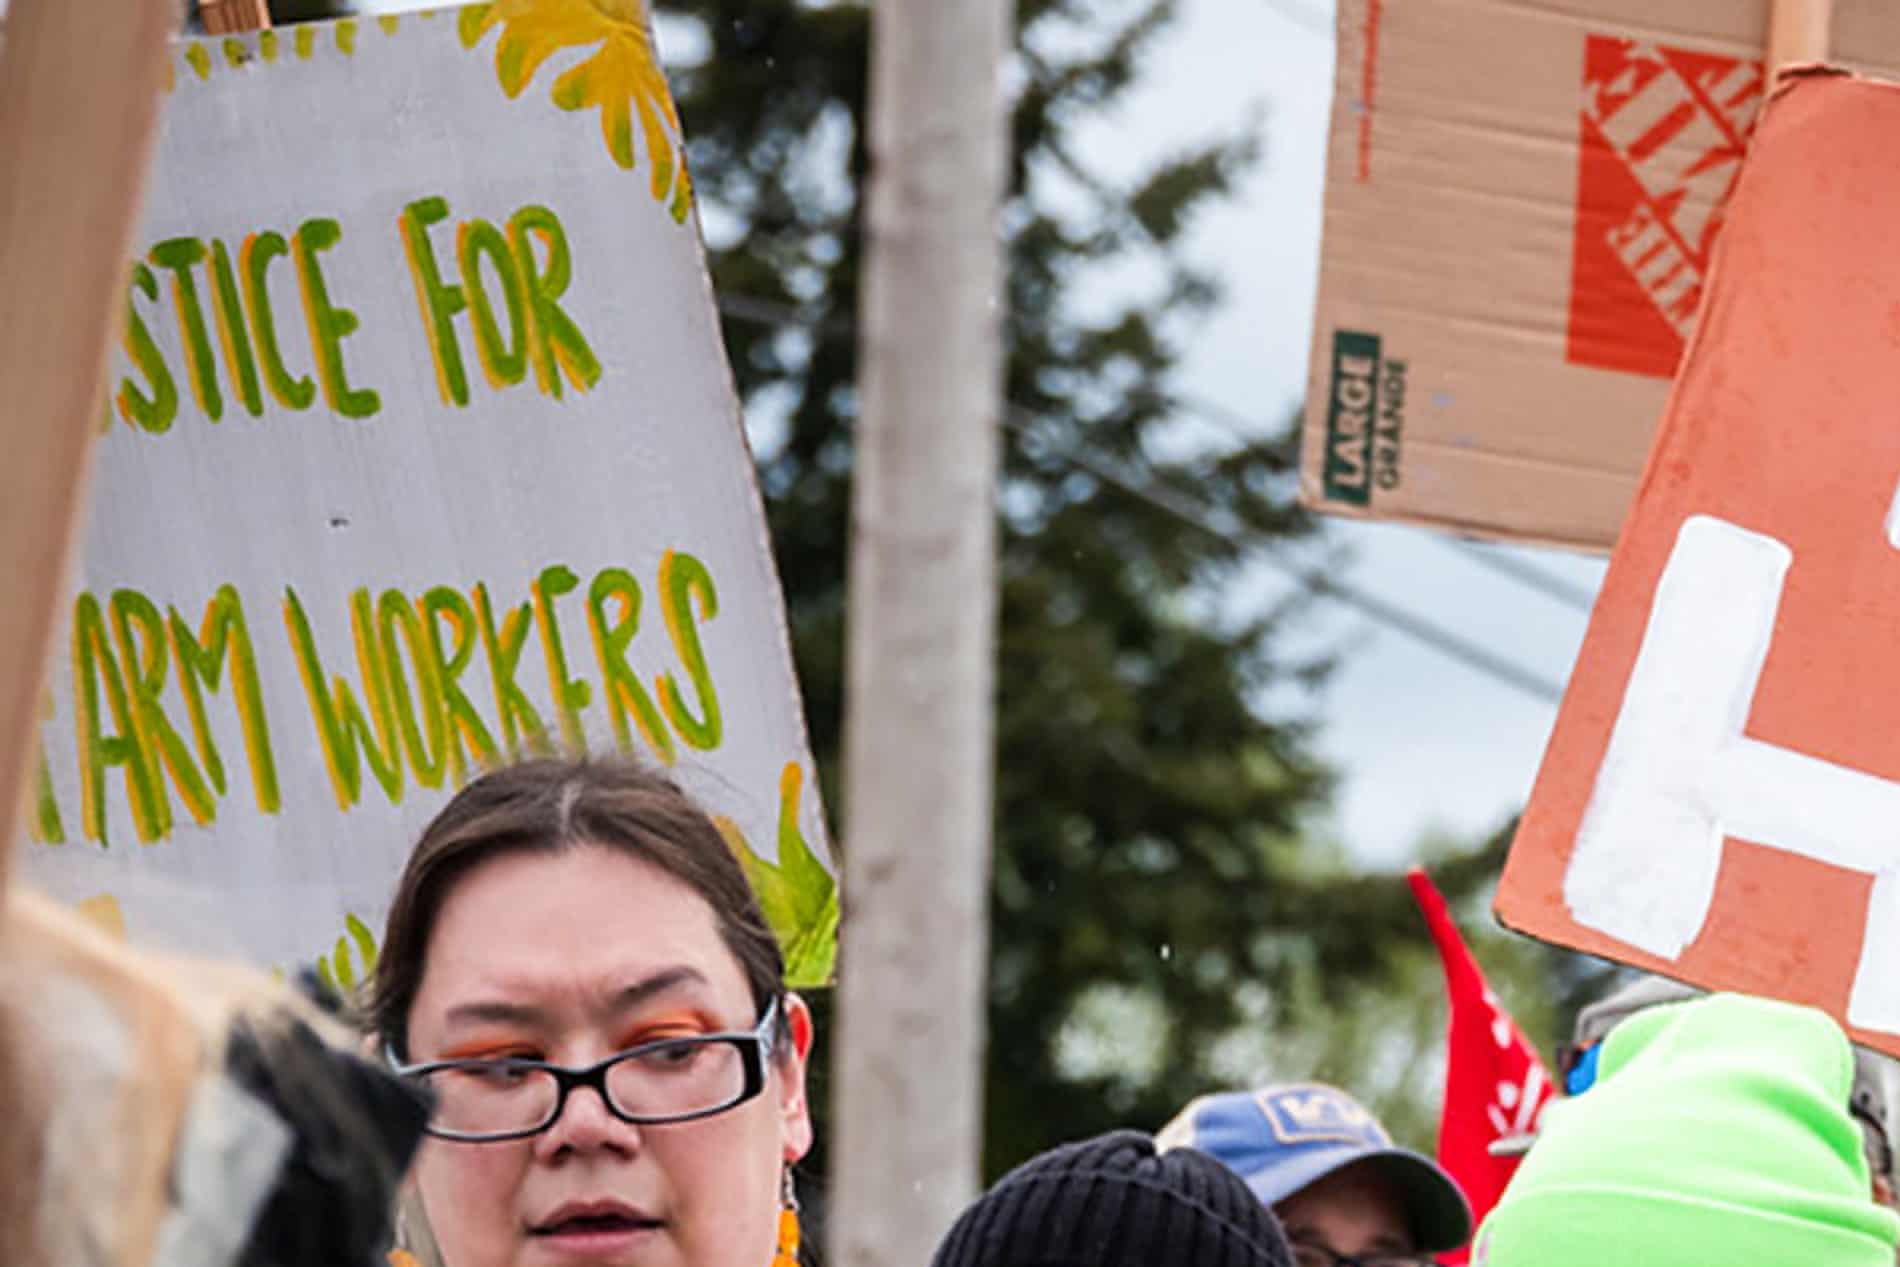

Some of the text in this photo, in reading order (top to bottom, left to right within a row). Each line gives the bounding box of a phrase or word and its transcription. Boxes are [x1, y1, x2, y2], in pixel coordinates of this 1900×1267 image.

[98, 197, 602, 435] STICE FOR
[1332, 356, 1374, 488] LARGE
[1375, 361, 1407, 490] GRANDE
[282, 547, 722, 813] WORKERS
